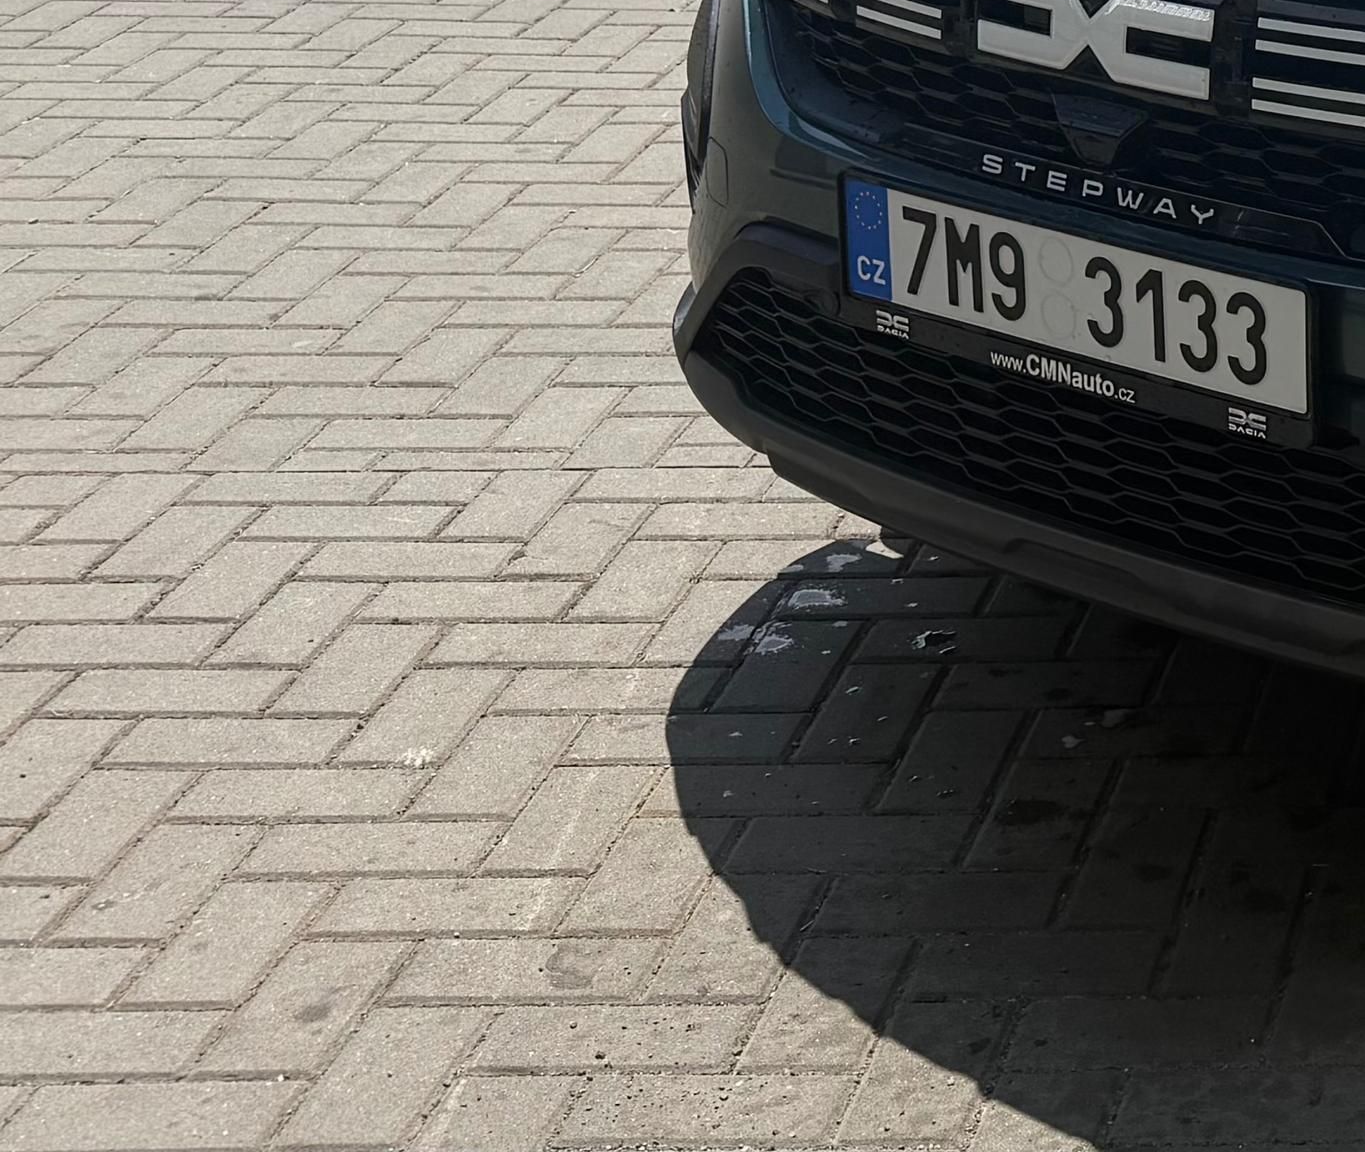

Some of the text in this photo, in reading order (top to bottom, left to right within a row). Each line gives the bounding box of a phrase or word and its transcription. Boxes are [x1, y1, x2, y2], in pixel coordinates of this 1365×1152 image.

[981, 153, 1215, 225] STEPWAY
[857, 255, 886, 285] CZ
[902, 205, 1267, 385] 7M9 3133
[877, 325, 909, 339] DACIA
[990, 351, 1136, 403] www.CMNauto.cz
[1228, 423, 1266, 439] DACIA
